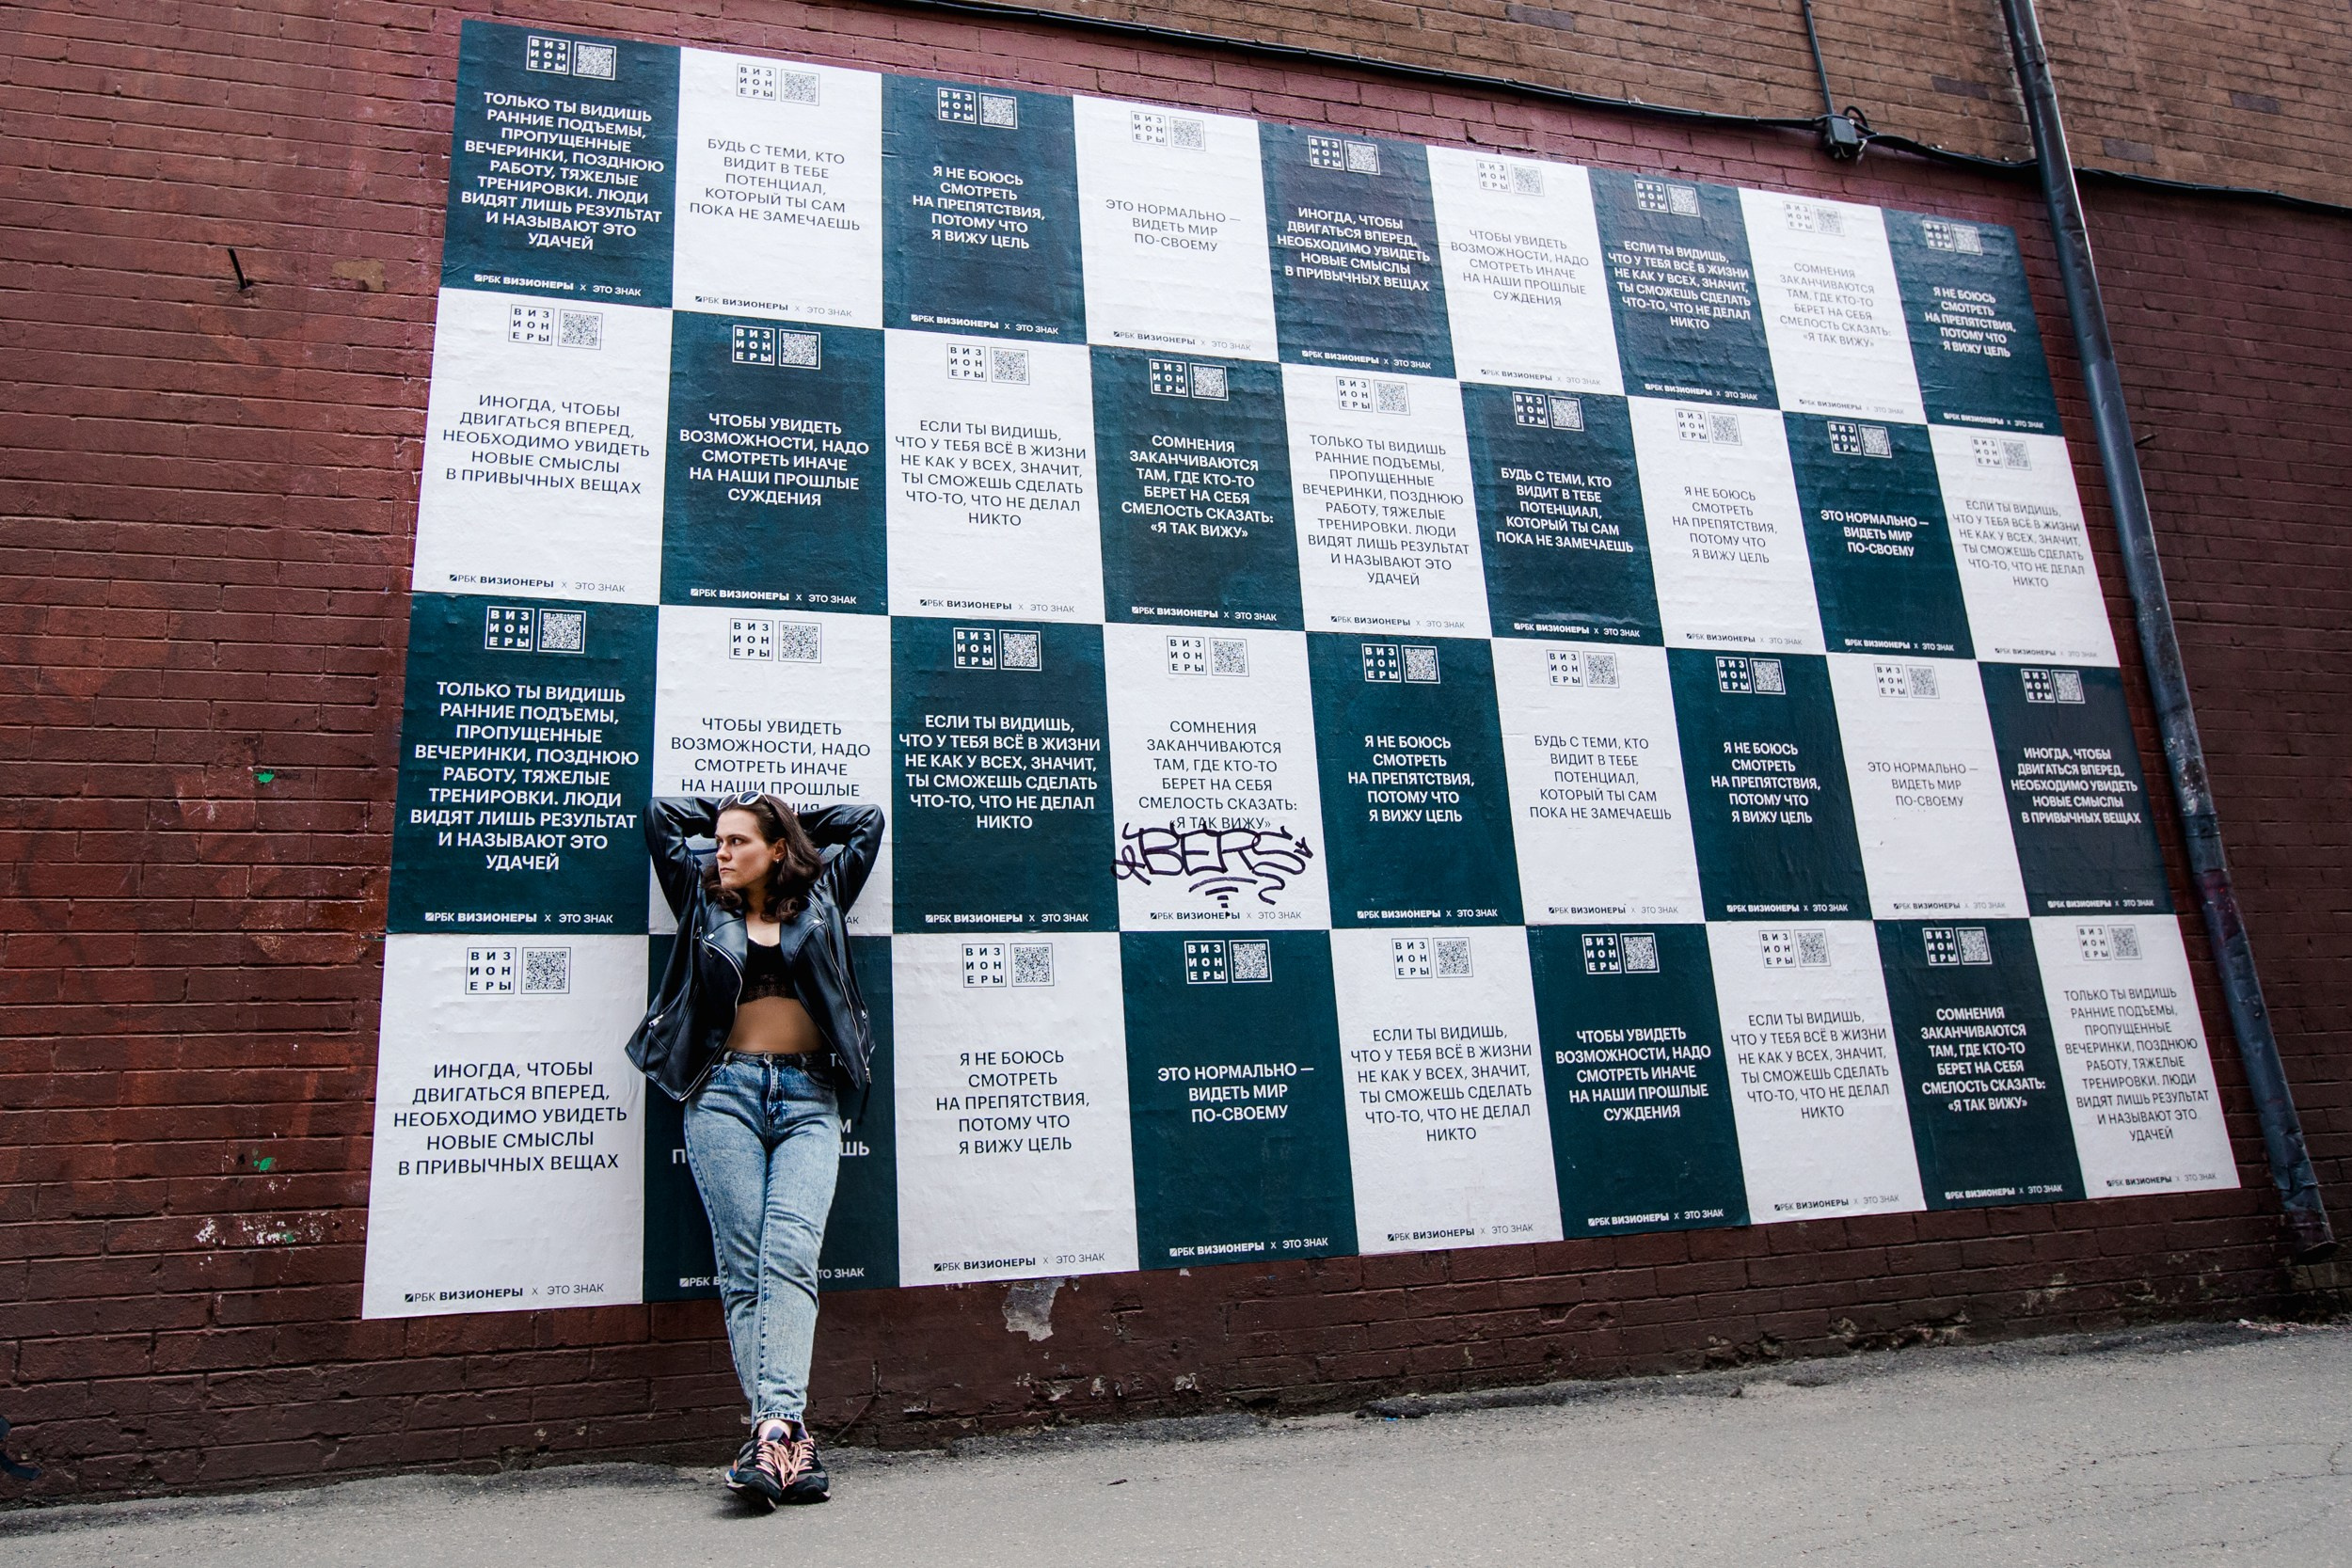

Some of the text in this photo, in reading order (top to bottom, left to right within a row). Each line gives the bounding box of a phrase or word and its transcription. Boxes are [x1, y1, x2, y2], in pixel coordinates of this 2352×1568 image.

[483, 91, 652, 122] ТОЛЬКО ТЫ ВИДИШЬ
[460, 190, 663, 223] ВИДЯТ ЛИШЬ РЕЗУЛЬТАТ
[705, 186, 845, 214] КОТОРЫЙ ТЫ САМ
[912, 194, 1045, 221] НА ПРЕПЯТСТВИЯ,
[1132, 216, 1218, 237] ВИДЕТЬ МИР
[1134, 232, 1218, 252] ПО-СВОЕМУ
[1276, 233, 1431, 262] НЕОБХОДИМО УВИДЕТЬ
[1450, 241, 1589, 267] ВОЗМОЖНОСТИ, НАДО
[481, 274, 642, 296] РБК ВИЗИОНЕРЫ ЭТО ЗНАК
[1615, 280, 1751, 307] ТЫ СМОЖЕШЬ СДЕЛАТЬ
[1932, 286, 1996, 304] Я НЕ БОЮСЬ
[707, 412, 842, 435] ЧТОБЫ УВИДЕТЬ
[919, 419, 1061, 442] ЕСЛИ ТЫ ВИДИШЬ,
[445, 467, 641, 495] В ПРИВЫЧНЫХ ВЕЩАХ
[727, 487, 821, 506] СУЖДЕНИЯ
[1302, 483, 1464, 505] ВЕЧЕРИНКИ, ПОЗДНЮЮ
[1120, 500, 1274, 524] СМЕЛОСТЬ СКАЗАТЬ:
[1691, 501, 1754, 516] СМОТРЕТЬ
[1495, 531, 1634, 553] ПОКА НЕ ЗАМЕЧАЕШЬ
[1842, 526, 1913, 542] ВИДЕТЬ МИР
[1846, 541, 1915, 557] ПО-СВОЕМУ
[1366, 571, 1420, 586] УДАЧЕЙ
[697, 587, 857, 605] РБК ВИЗИОНЕРЫ ЭТО ЗНАК
[1137, 606, 1278, 622] РБК ВИЗИОНЕРЫ ЭТО ЗНАК
[439, 702, 619, 725] РАННИЕ ПОДЪЕМЫ,
[1169, 720, 1257, 735] СОМНЕНИЯ
[671, 736, 870, 758] ВОЗМОЖНОСТИ, НАДО
[1534, 735, 1649, 750] БУДЬ С ТЕМИ, КТО
[904, 752, 1097, 772] НЕ КАК У ВСЕХ, ЗНАЧИТ,
[1152, 757, 1278, 773] ТАМ, ГДЕ КТО-ТО
[1372, 752, 1447, 768] СМОТРЕТЬ
[442, 766, 611, 785] РАБОТУ, ТЯЖЕЛЫЕ
[1553, 770, 1639, 785] ПОТЕНЦИАЛ,
[1890, 778, 1962, 791] ВИДЕТЬ МИР
[2010, 778, 2138, 793] НЕОБХОДИМО УВИДЕТЬ
[680, 778, 861, 798] НА НАШИ ПРОШЛЫЕ
[1728, 792, 1809, 806] ПОТОМУ ЧТО
[1895, 795, 1963, 807] ПО-СВОЕМУ
[433, 911, 613, 924] РБК ВИЗИОНЕРЫ ЭТО ЗНАК
[932, 912, 1089, 924] РБК ВИЗИОНЕРЫ ЭТО ЗНАК
[1919, 1022, 2027, 1039] ЗАКАНЧИВАЮТСЯ
[960, 1050, 1064, 1067] Я НЕ БОЮСЬ
[1157, 1066, 1191, 1082] ЭТО
[1194, 1062, 1297, 1081] НОРМАЛЬНО
[1740, 1064, 1889, 1085] ТЫ СМОЖЕШЬ СДЕЛАТЬ
[2161, 1072, 2197, 1086] ЛЮДИ
[411, 1084, 610, 1105] ДВИГАТЬСЯ ВПЕРЕД,
[1568, 1083, 1709, 1103] НА НАШИ ПРОШЛЫЕ
[393, 1106, 628, 1128] НЕОБХОДИМО УВИДЕТЬ
[958, 1114, 1070, 1132] ПОТОМУ ЧТО
[1364, 1103, 1531, 1124] ЧТО-ТО, ЧТО НЕ ДЕЛАЛ
[1593, 1208, 1724, 1227] РБК ВИЗИОНЕРЫ ЭТО ЗНАК
[1176, 1236, 1328, 1257] РБК ВИЗИОНЕРЫ ЭТО ЗНАК
[834, 1267, 866, 1279] ЗНАК
